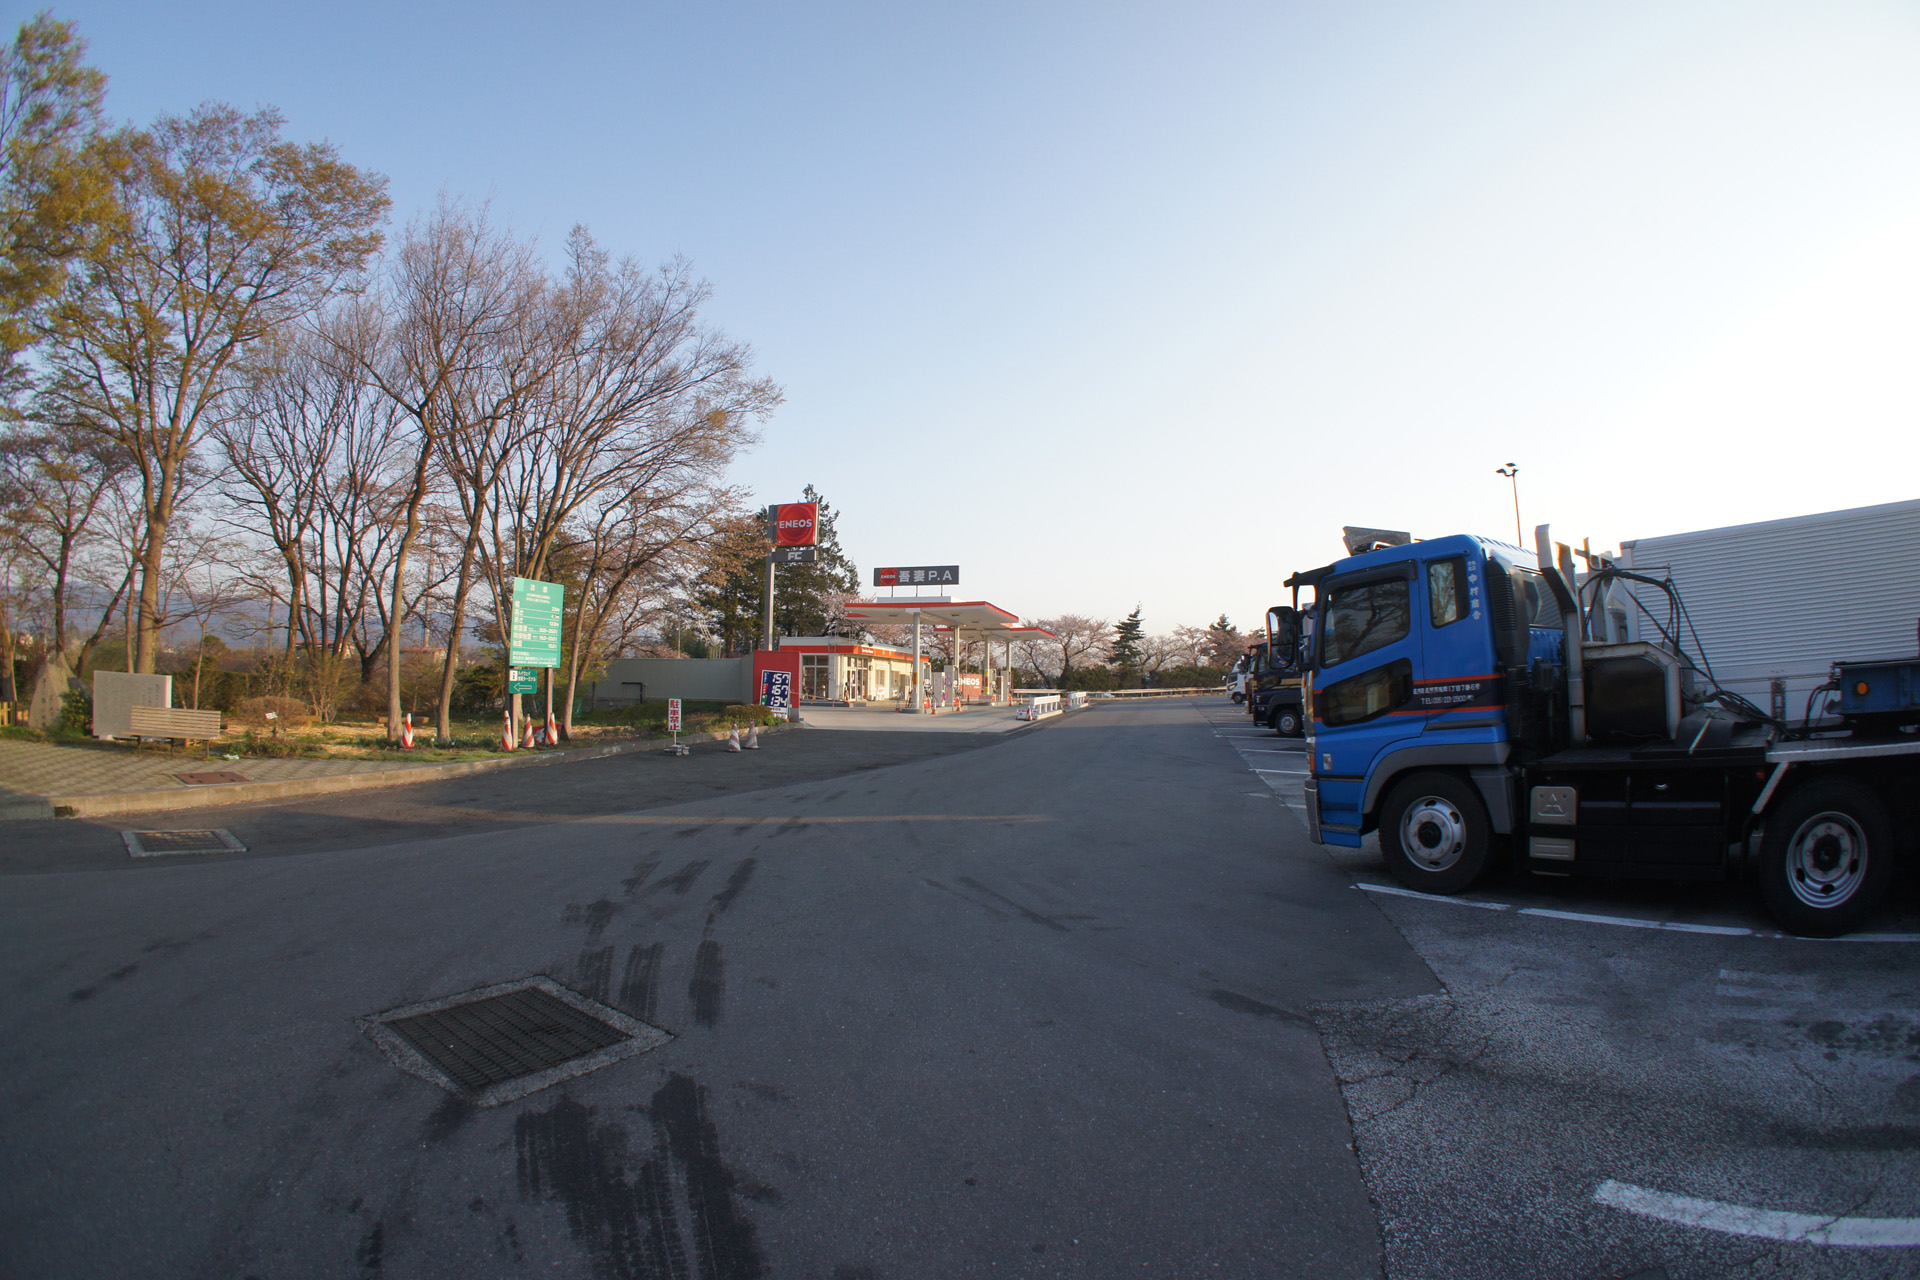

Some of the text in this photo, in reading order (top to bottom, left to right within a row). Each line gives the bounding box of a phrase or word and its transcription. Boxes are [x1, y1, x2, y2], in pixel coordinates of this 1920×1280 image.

[779, 519, 813, 529] ENEOS
[788, 552, 802, 560] FC
[772, 673, 789, 684] 157
[771, 684, 788, 695] 167
[770, 696, 788, 707] 134
[670, 699, 680, 731] 駐車禁止
